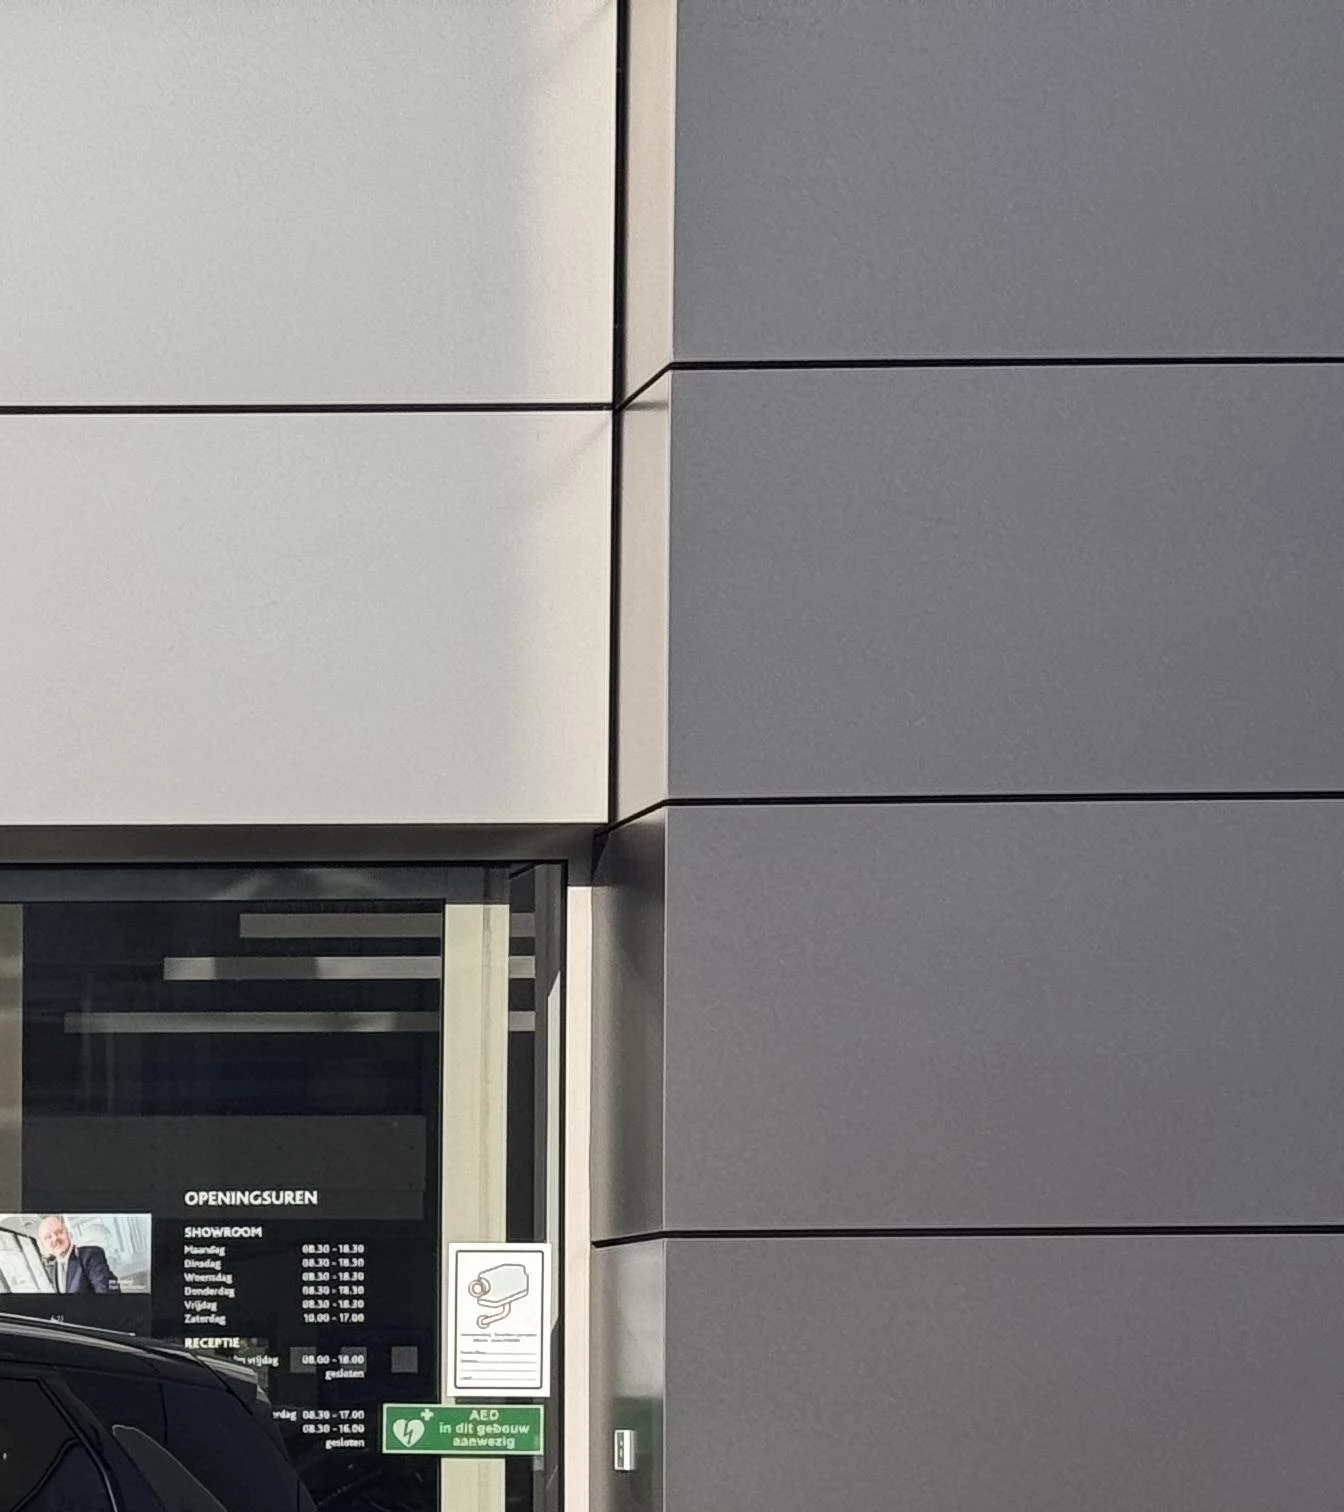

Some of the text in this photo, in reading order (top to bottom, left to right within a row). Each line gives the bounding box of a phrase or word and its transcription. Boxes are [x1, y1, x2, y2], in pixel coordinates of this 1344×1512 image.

[184, 1190, 319, 1206] OPENINGSUREN
[184, 1226, 263, 1238] SHOWROOM
[184, 1245, 226, 1257] Maandag
[184, 1259, 222, 1271] Dinsdag
[184, 1273, 233, 1285] Woensdag
[184, 1287, 236, 1299] Donderdag
[184, 1300, 218, 1312] Vrijdag
[184, 1314, 227, 1326] Zaterdag
[185, 1338, 241, 1349] RECEPTIE
[325, 1367, 365, 1380] gesloten
[469, 1409, 500, 1421] AED
[439, 1422, 530, 1436] in dit gebouw
[325, 1437, 365, 1450] gesloten
[452, 1435, 515, 1449] aanwezig
